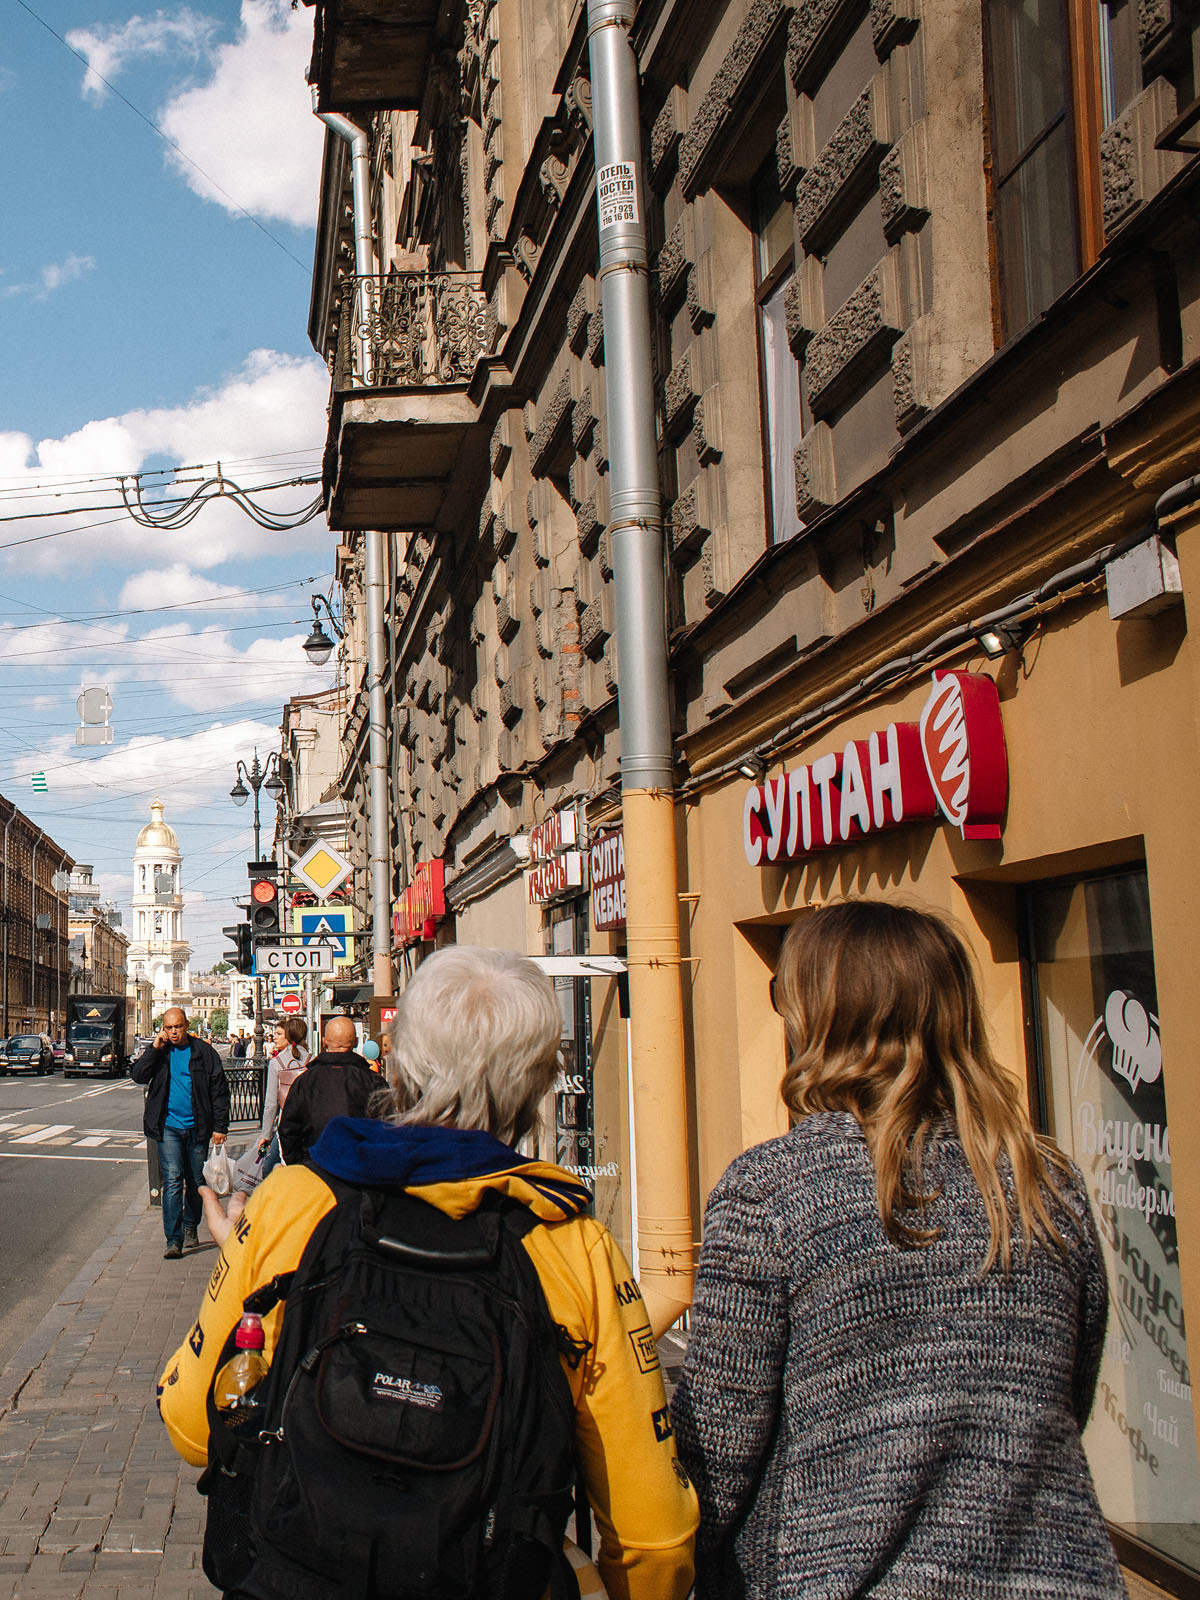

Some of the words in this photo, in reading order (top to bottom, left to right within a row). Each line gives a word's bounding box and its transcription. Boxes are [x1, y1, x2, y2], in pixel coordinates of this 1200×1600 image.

[600, 180, 633, 198] ХОСТЕЛ
[601, 165, 630, 181] ОТЕЛЬ
[743, 722, 904, 867] СУЛТАН
[531, 812, 562, 861] СТУДИЯ
[528, 853, 567, 905] КРАСОТЫ
[268, 951, 321, 968] СТОП
[374, 1372, 411, 1390] POLAR
[1143, 1401, 1180, 1448] Чай
